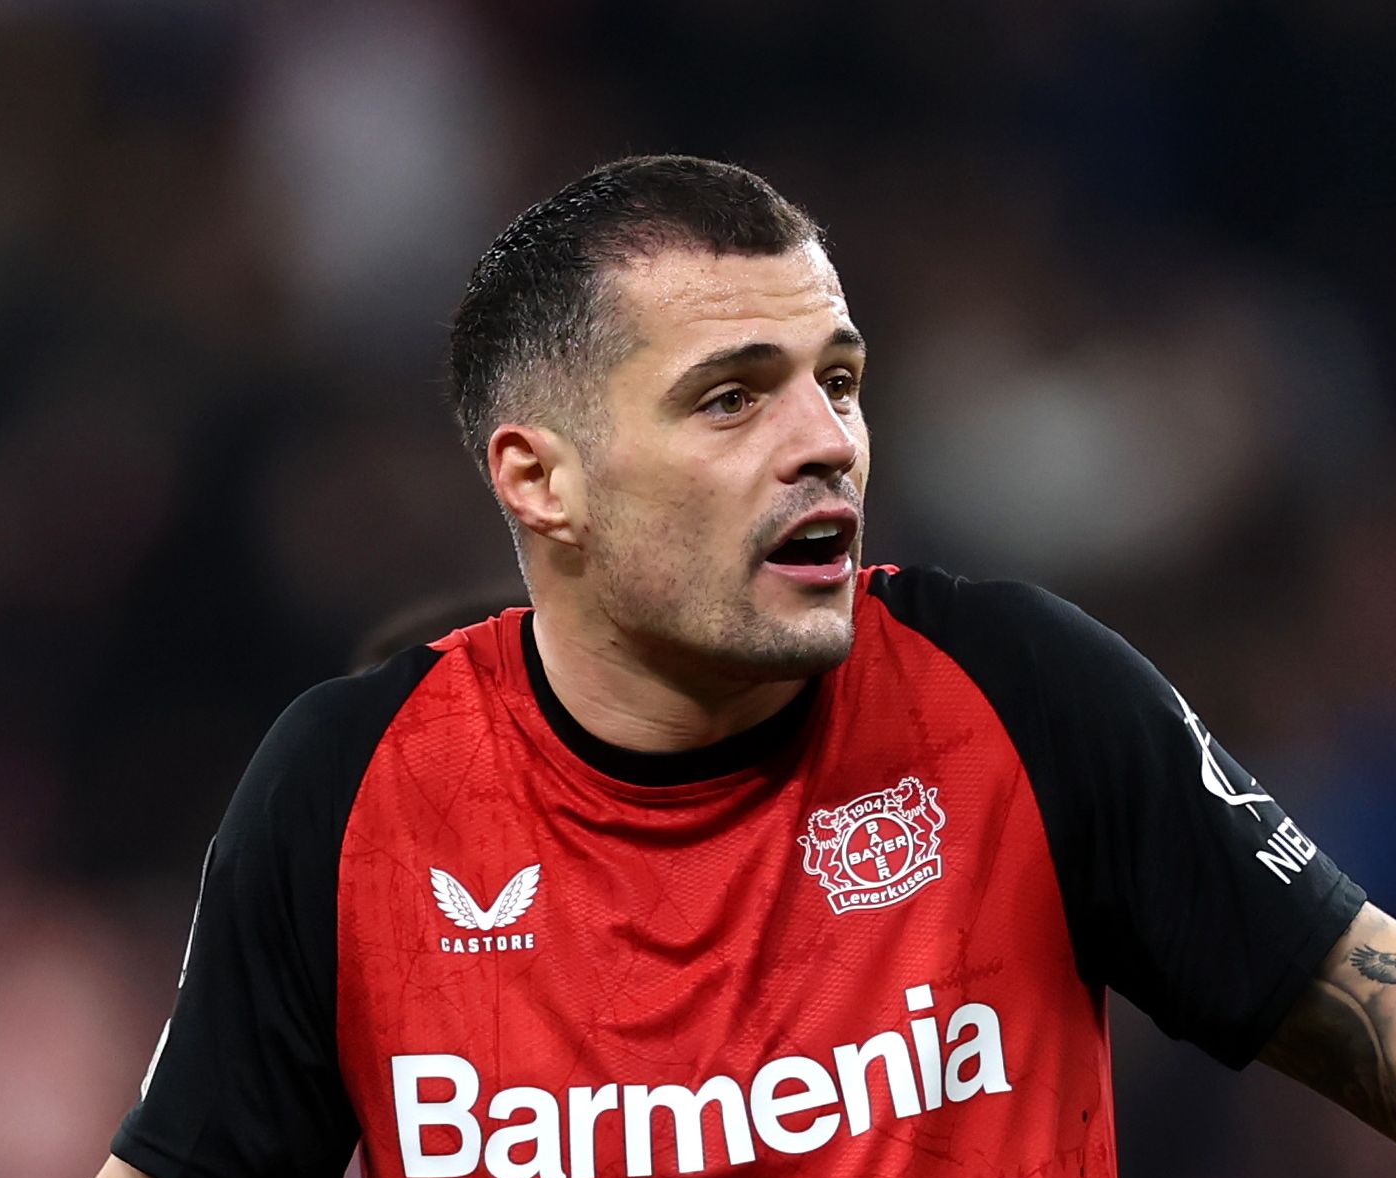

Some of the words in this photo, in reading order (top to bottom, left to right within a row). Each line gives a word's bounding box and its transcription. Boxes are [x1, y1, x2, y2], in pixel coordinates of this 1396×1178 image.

[849, 800, 883, 819] 1904
[848, 835, 907, 865] BAYER
[865, 820, 892, 880] BAYER
[1256, 817, 1317, 884] NIE
[839, 865, 934, 907] Leverkusen
[441, 933, 534, 953] CASTORE
